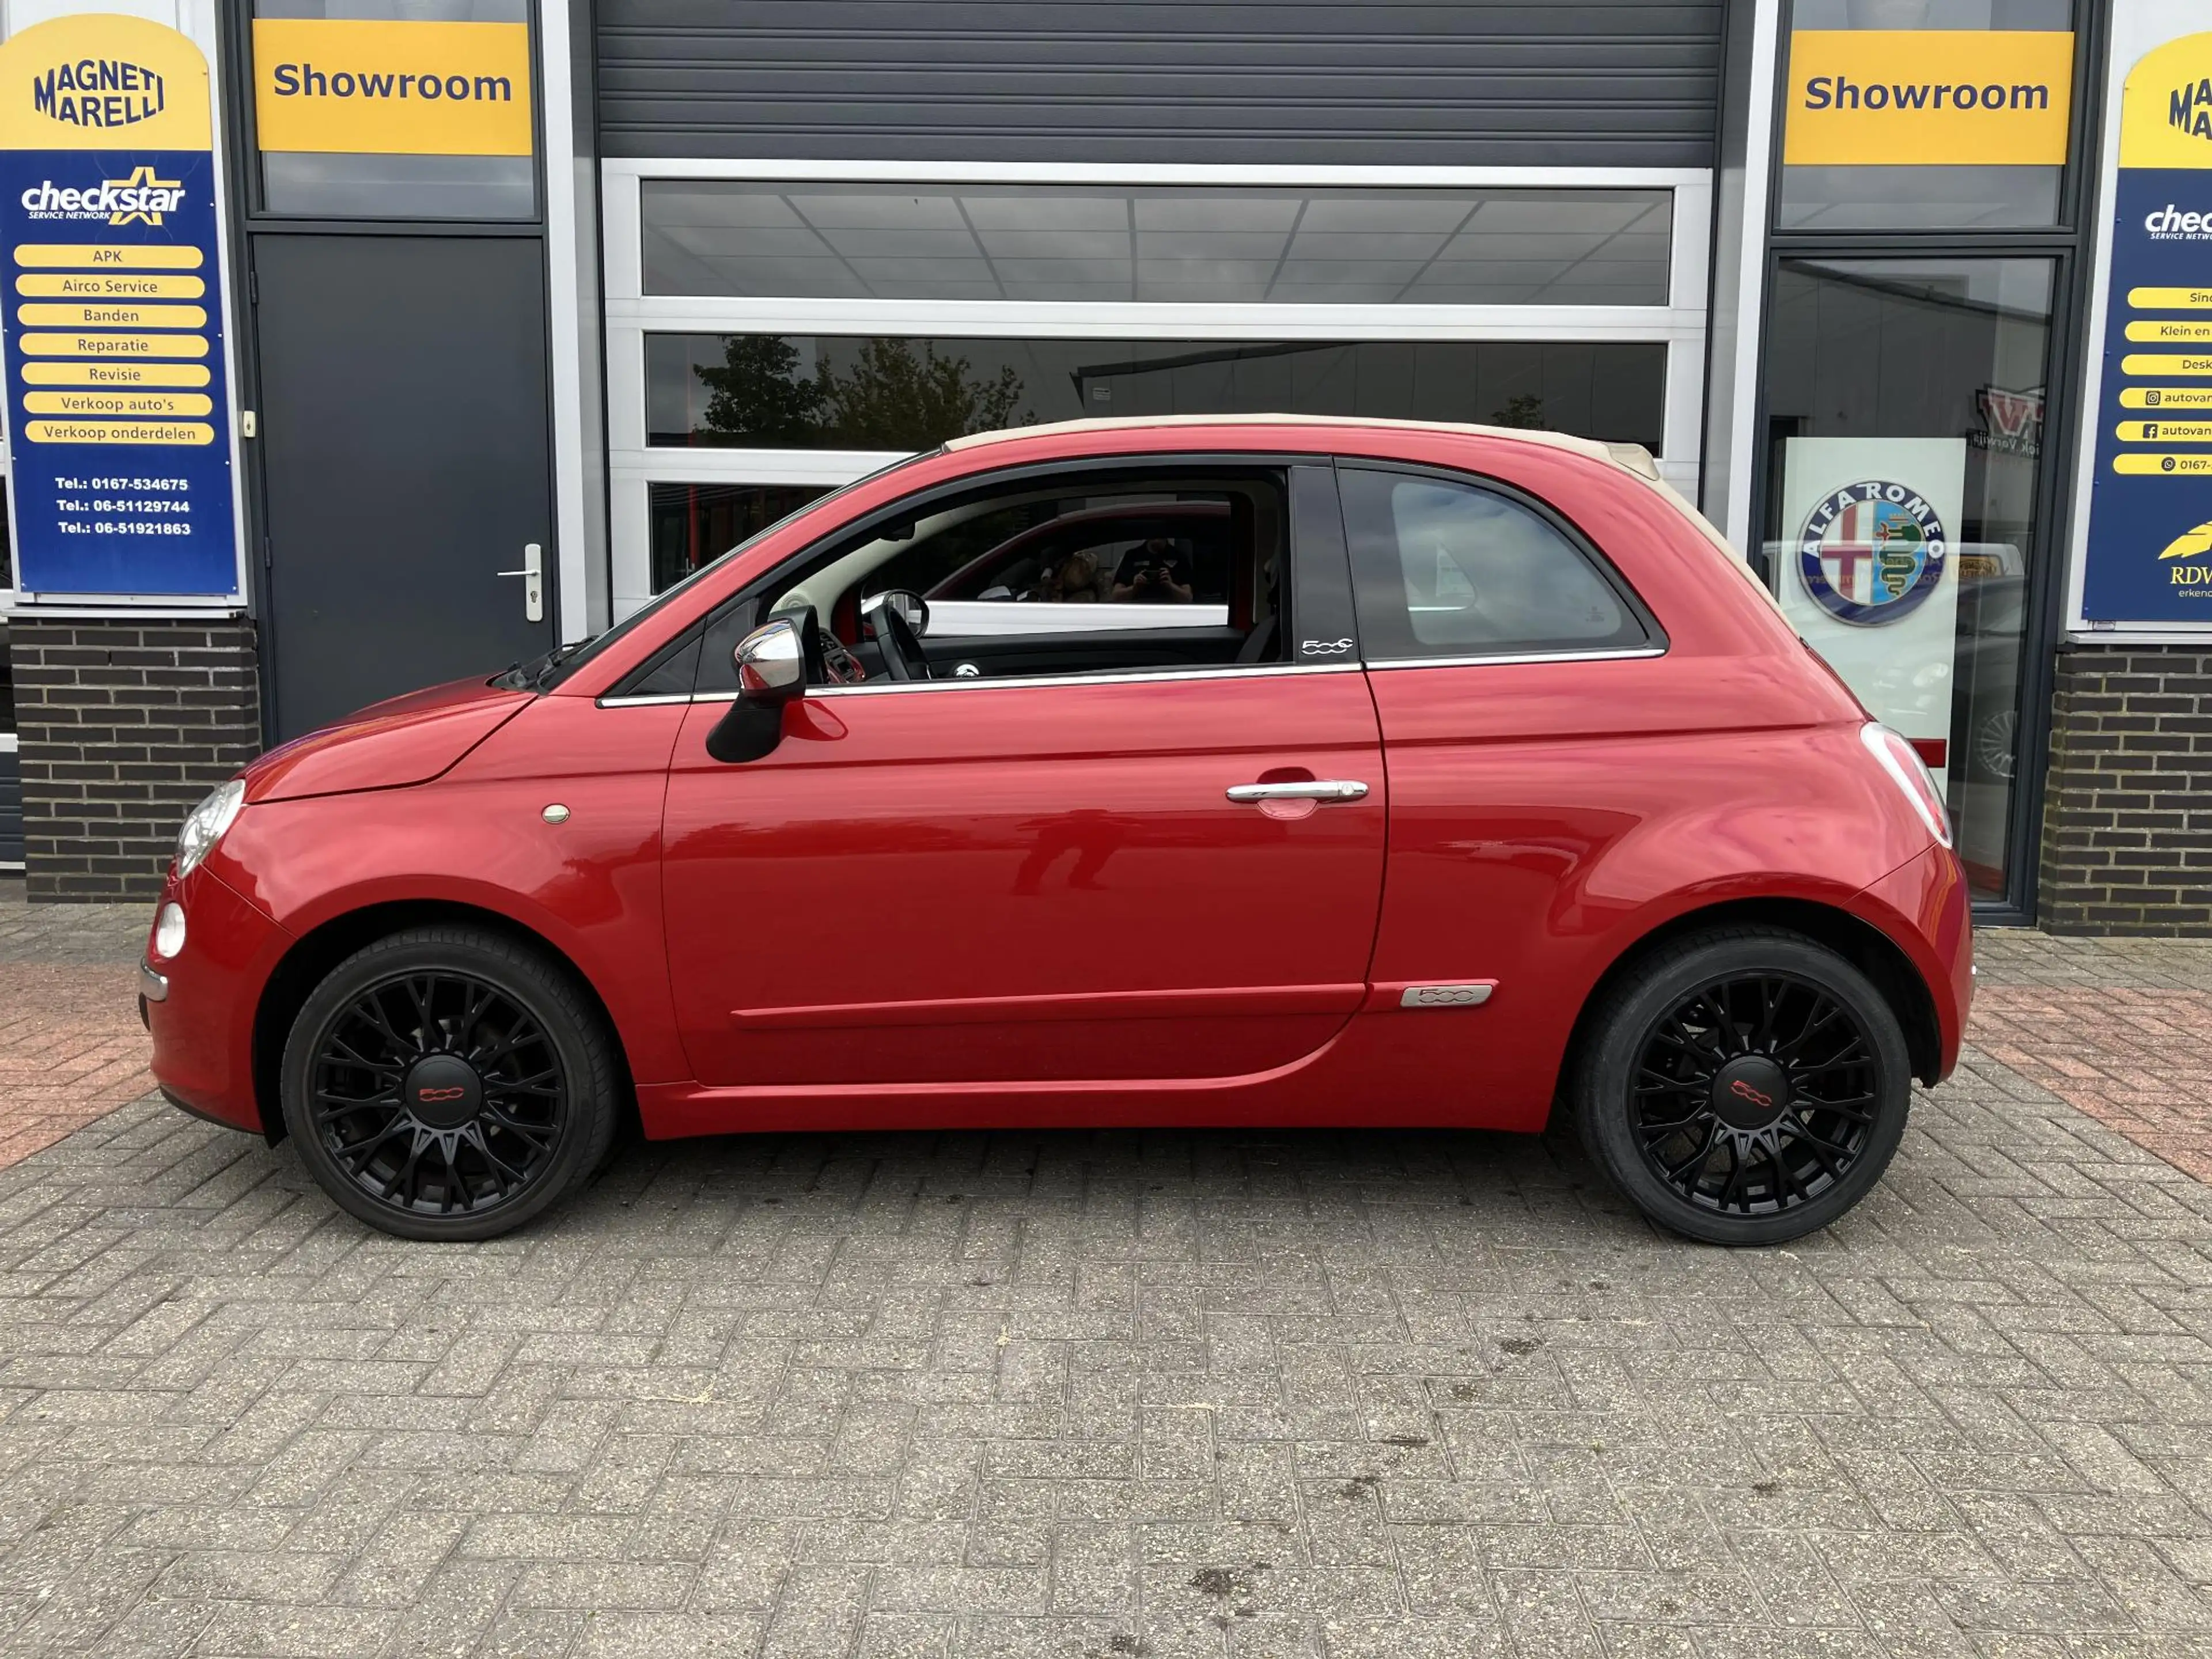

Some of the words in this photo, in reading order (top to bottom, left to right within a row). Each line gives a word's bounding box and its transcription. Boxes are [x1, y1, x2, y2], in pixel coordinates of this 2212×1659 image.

[33, 59, 164, 119] MAGNETI
[274, 63, 511, 101] Showroom
[33, 69, 164, 127] MARELLI
[1805, 76, 2048, 109] Showroom
[21, 180, 185, 211] checkstar
[65, 211, 111, 219] NETWORK
[93, 251, 123, 262] APK
[62, 280, 100, 291] Airco
[106, 281, 158, 293] Service
[2190, 293, 2212, 302] Sin
[84, 309, 139, 321] Banden
[2161, 325, 2191, 335] Klein
[78, 339, 149, 354] Reparatie
[89, 368, 141, 381] Revisie
[61, 397, 124, 411] Verkoop
[129, 399, 174, 411] auto's
[44, 425, 106, 440] Verkoop
[111, 427, 195, 440] onderdelen
[2180, 460, 2212, 469] 0167-
[55, 477, 87, 489] Tel.:
[92, 478, 188, 491] 0167-534675
[56, 499, 89, 511] Tel.:
[93, 500, 190, 513] 06-51129744
[1802, 490, 1857, 559] ALFA
[1856, 482, 1945, 559] ROMEO
[58, 522, 90, 533] Tel.:
[95, 522, 191, 535] 06-51921863
[1419, 989, 1474, 1003] 500
[419, 1088, 464, 1101] 500
